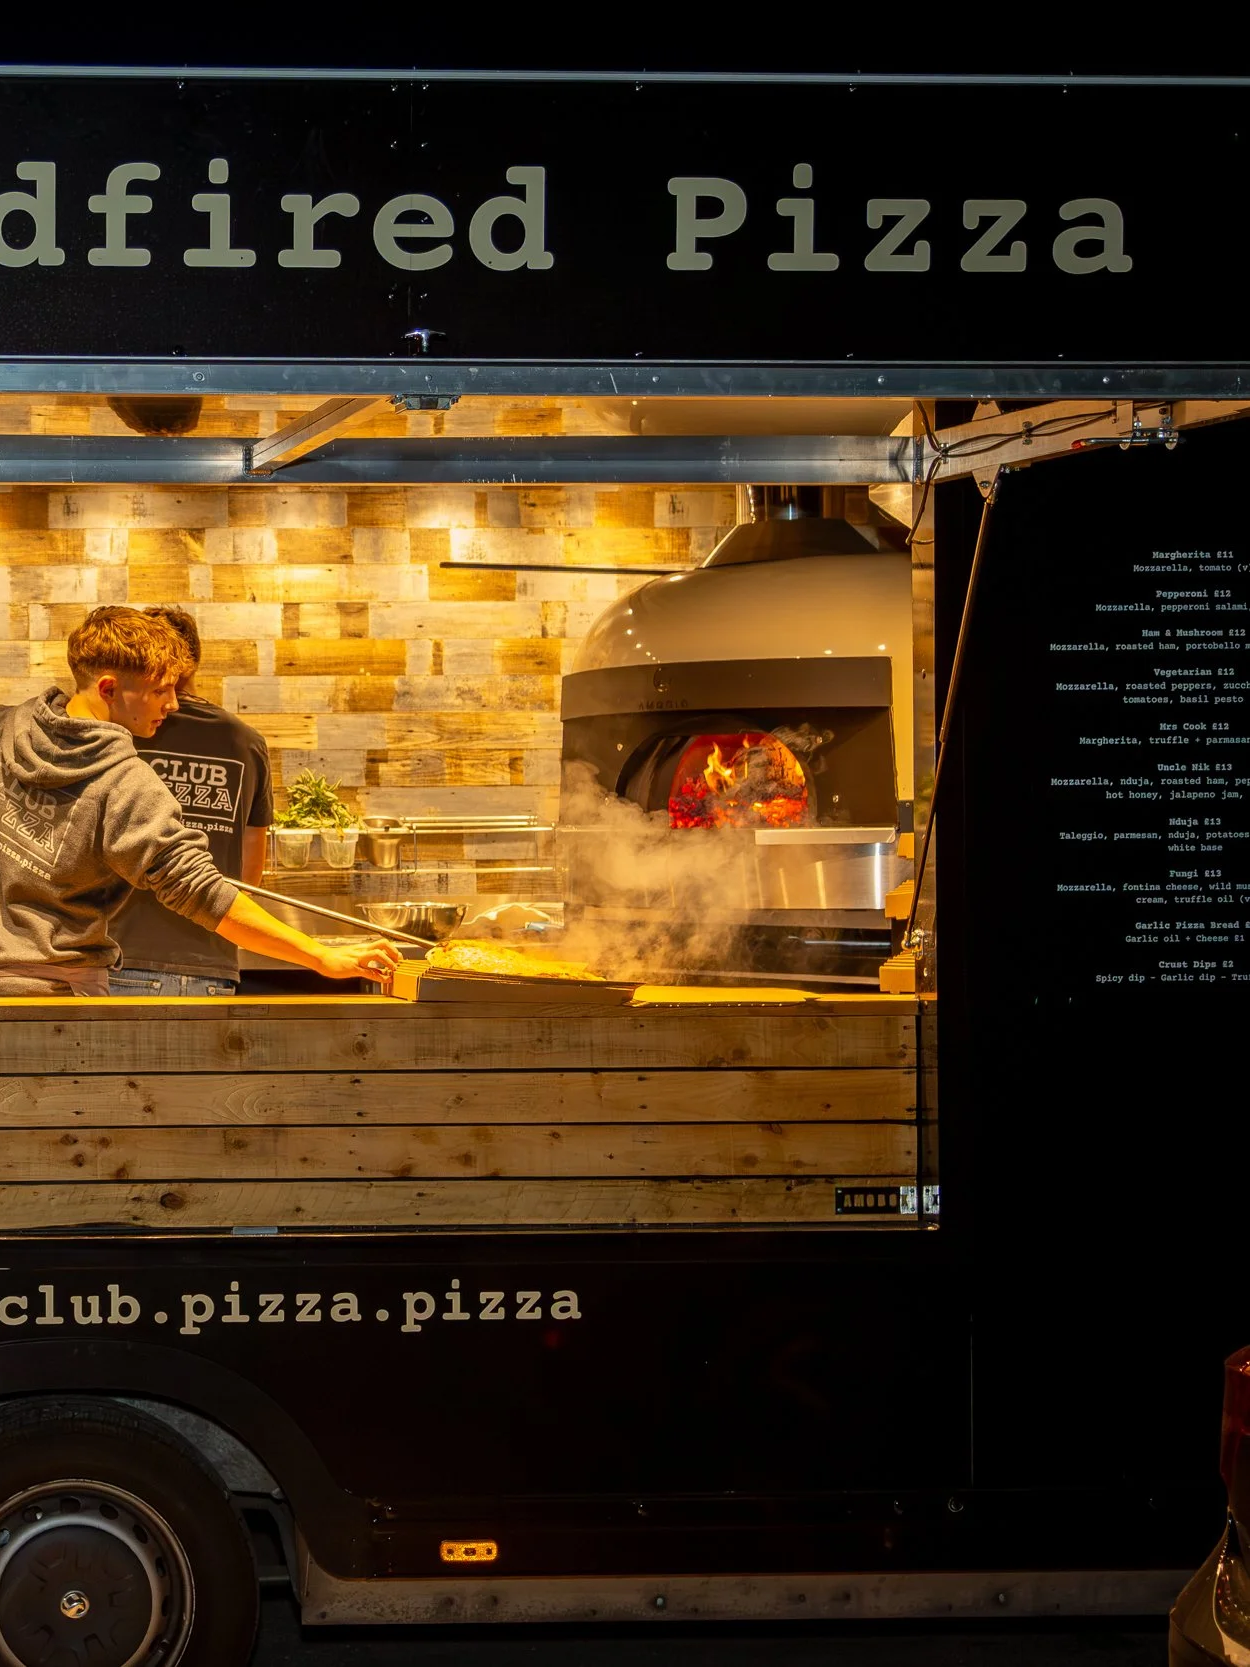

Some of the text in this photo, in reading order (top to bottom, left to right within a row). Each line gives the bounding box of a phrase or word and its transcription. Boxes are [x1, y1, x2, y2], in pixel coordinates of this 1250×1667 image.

[666, 162, 1133, 275] Pizza
[1152, 550, 1234, 561] Margherita £11
[1133, 563, 1193, 573] Mozzarella,
[1198, 564, 1232, 572] tomato
[1155, 589, 1232, 600] Pepperoni £12
[1095, 602, 1155, 612] Mozzarella,
[1160, 602, 1210, 613] pepperoni
[1141, 629, 1161, 637] Ham
[1175, 628, 1224, 637] Mushroom
[1228, 628, 1246, 637] £12
[1049, 642, 1109, 652] Mozzarella,
[1115, 641, 1154, 651] roasted
[1158, 641, 1180, 651] ham,
[1185, 641, 1241, 652] portobello
[1153, 667, 1235, 678] Vegetarian £12
[1055, 681, 1119, 692] Mozzarella,
[1125, 681, 1167, 690] roasted
[1170, 682, 1217, 692] peppers,
[1122, 694, 1244, 705] tomatoes, basil pesto
[1159, 721, 1230, 731] Mrs Cook £12
[1079, 735, 1142, 747] Margherita,
[1148, 735, 1190, 745] truffle
[150, 758, 228, 787] CLUB
[1157, 762, 1233, 772] Uncle Nik £13
[1050, 776, 1114, 787] Mozzarella,
[1119, 776, 1154, 787] nduja,
[1160, 776, 1202, 785] roasted
[1205, 776, 1229, 786] ham,
[166, 781, 233, 811] ZZA
[1105, 789, 1243, 801] hot honey, jalapeno jam,
[1168, 817, 1222, 828] Nduja £13
[1059, 830, 1250, 842] Taleggio, parmesan, nduja, potatoes
[1167, 843, 1223, 852] white base
[1169, 868, 1222, 880] Fungi £13
[1056, 882, 1116, 893] Mozzarella,
[1122, 882, 1161, 891] fontina
[1165, 882, 1203, 892] cheese,
[1208, 881, 1232, 891] wild
[1135, 897, 1168, 905] cream,
[1174, 895, 1213, 904] truffle
[1217, 894, 1235, 903] oil
[1135, 920, 1171, 930] Garlic
[1175, 920, 1206, 930] Pizza
[1210, 920, 1240, 929] Bread
[1125, 934, 1159, 943] Garlic
[1163, 934, 1181, 943] oil
[1195, 933, 1229, 943] Cheese
[1234, 934, 1245, 942] £1
[1158, 959, 1234, 970] Crust Dips £2
[1095, 973, 1124, 984] Spicy
[1128, 973, 1146, 984] dip
[1160, 973, 1195, 982] Garlic
[1198, 973, 1216, 983] dip
